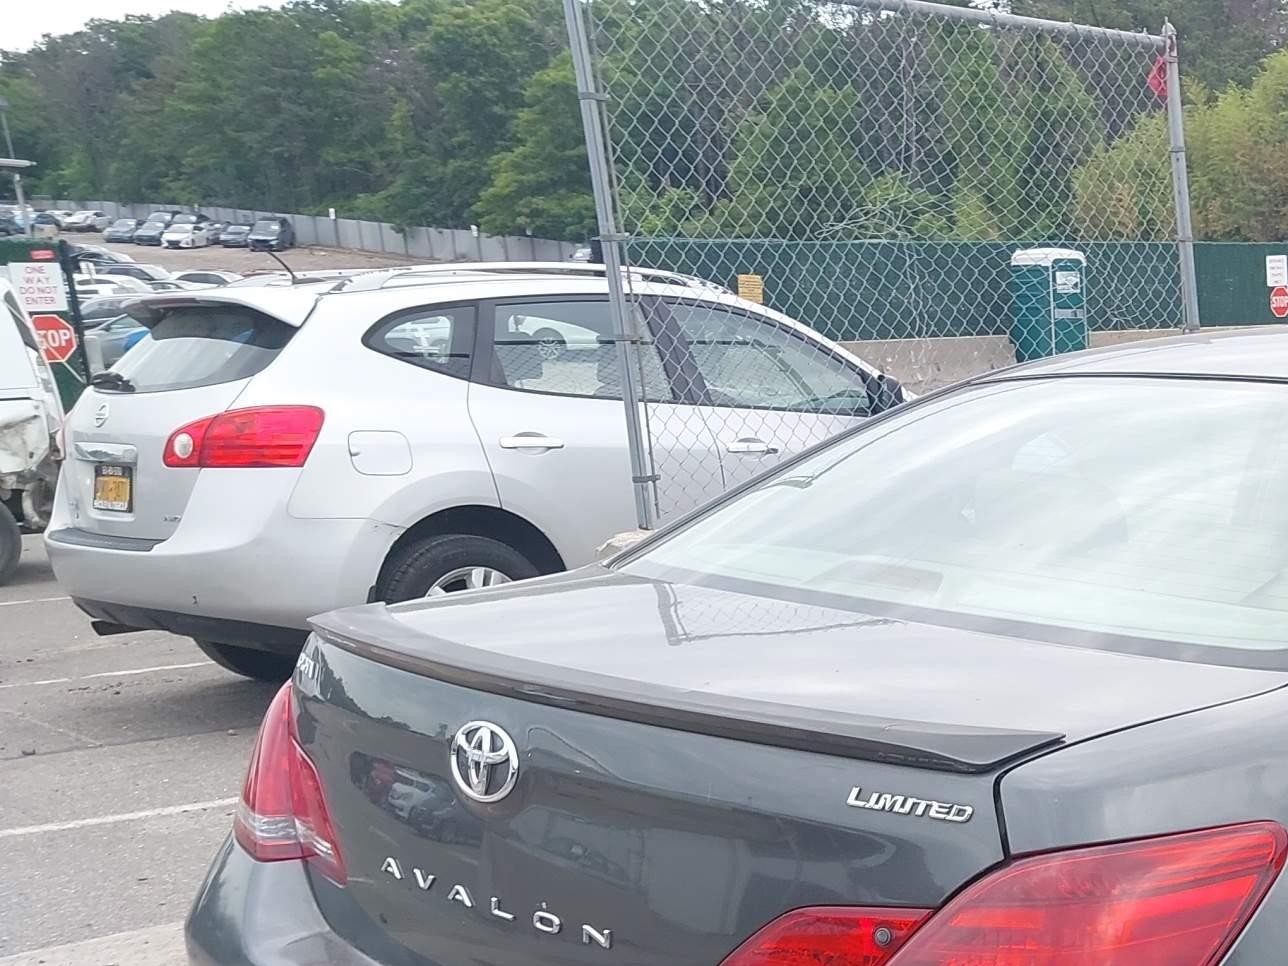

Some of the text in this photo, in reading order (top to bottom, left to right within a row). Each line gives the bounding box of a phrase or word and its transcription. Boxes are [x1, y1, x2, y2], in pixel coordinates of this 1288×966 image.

[25, 265, 46, 274] ONE
[24, 277, 50, 285] WAY
[20, 286, 57, 295] DO NOT
[25, 296, 56, 305] ENTER
[36, 329, 70, 349] TOP
[846, 786, 975, 822] LIMITED
[381, 857, 612, 950] AVALON
